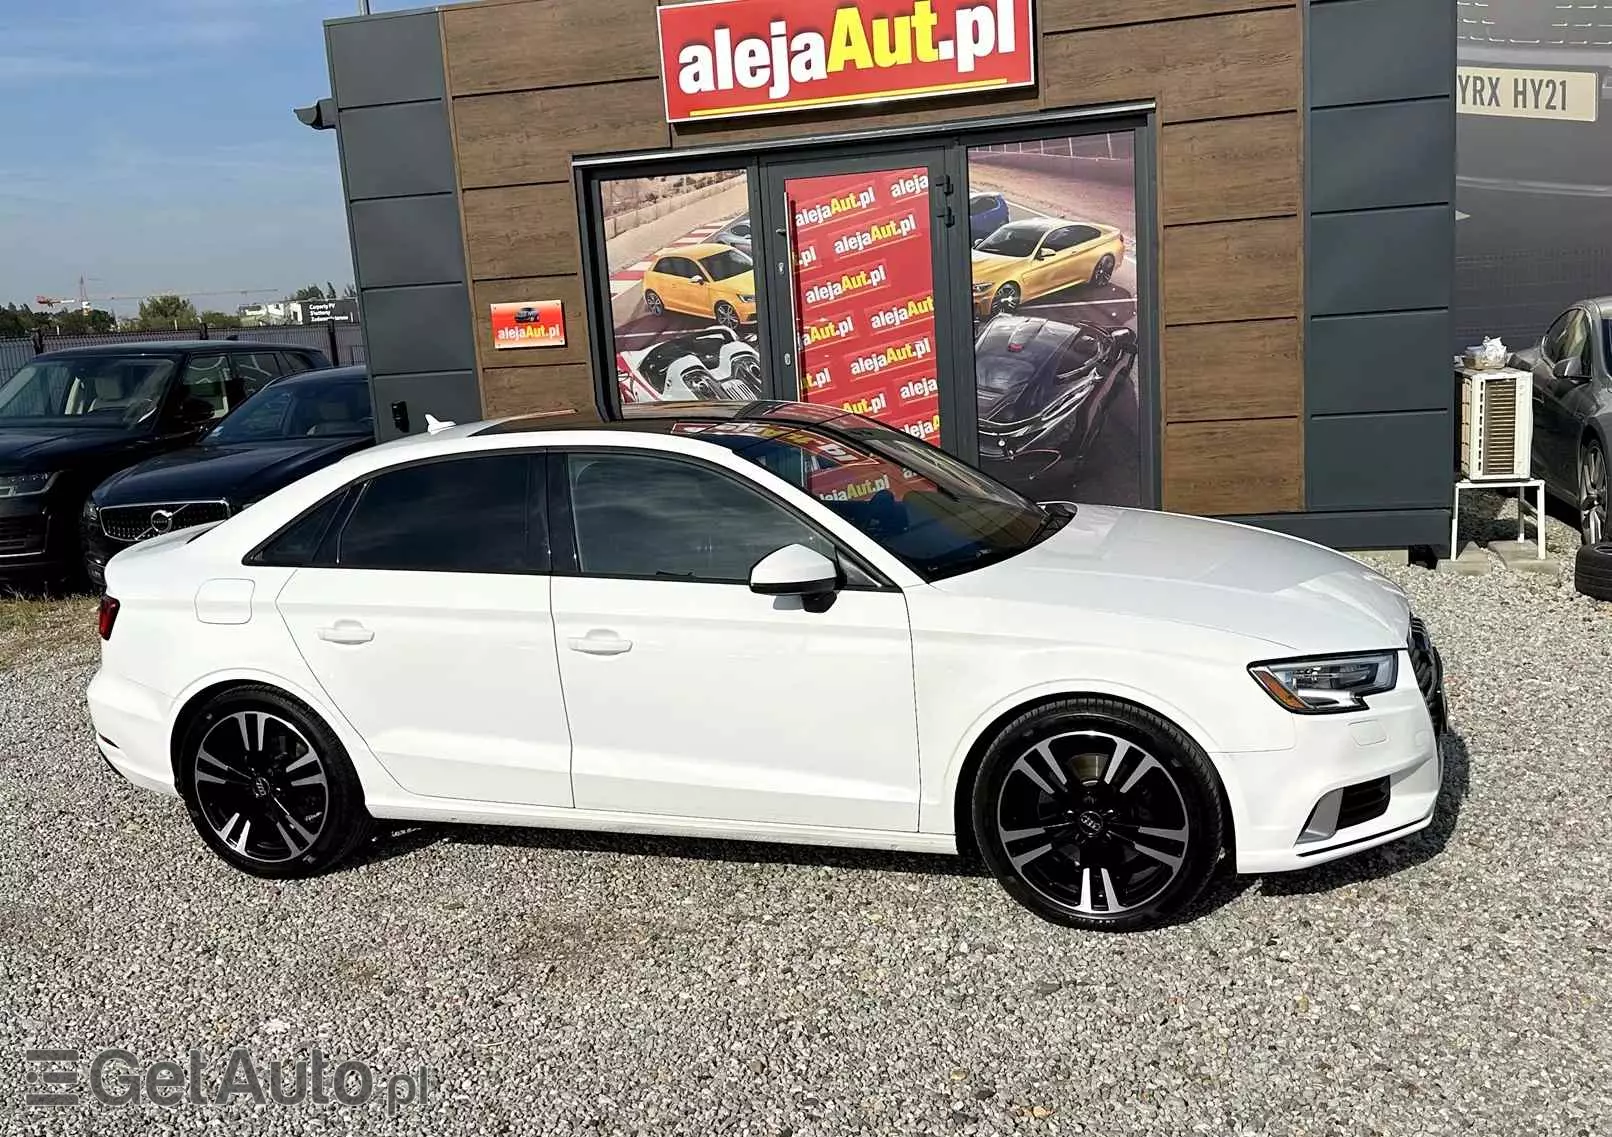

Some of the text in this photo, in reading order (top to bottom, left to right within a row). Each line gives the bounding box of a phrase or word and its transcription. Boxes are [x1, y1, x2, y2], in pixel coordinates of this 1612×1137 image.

[678, 0, 1016, 99] alejaAut.pl
[1457, 74, 1567, 111] YRX HY21
[890, 174, 929, 198] aleja
[795, 187, 876, 227] alejaAut.pl
[833, 214, 917, 255] alejaAut.pl
[805, 265, 887, 303] alejaAut.pl
[870, 296, 935, 329] alejaAut
[497, 324, 560, 341] alejaAut.pl
[850, 337, 931, 376] alejaAut.pl
[900, 377, 938, 399] aleja
